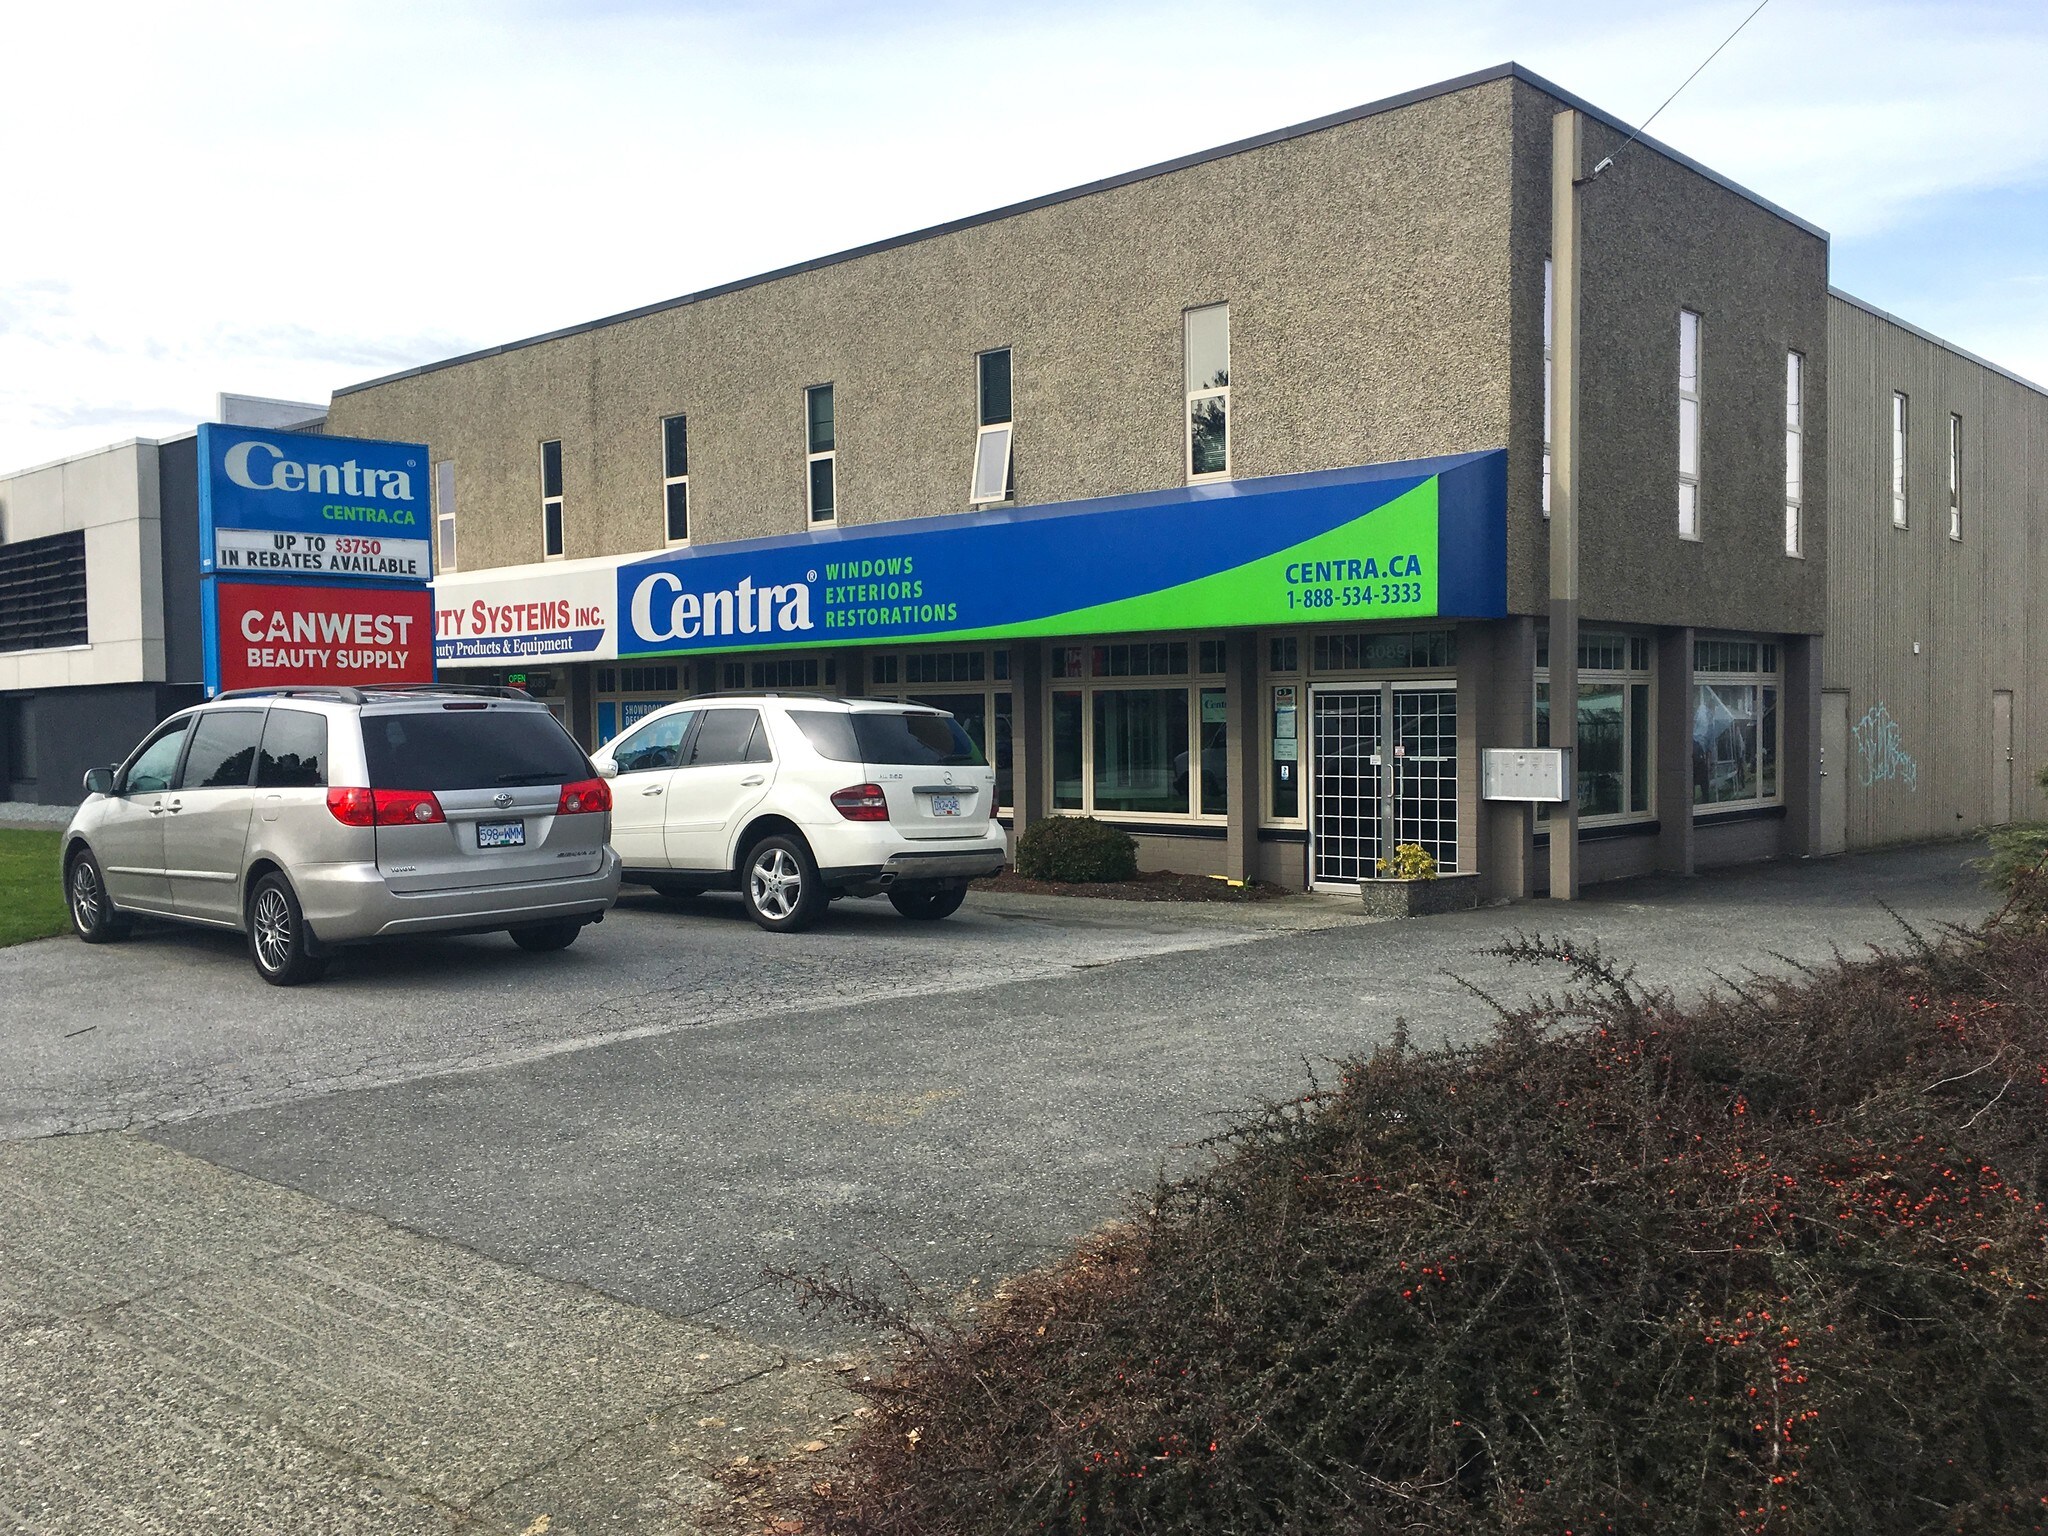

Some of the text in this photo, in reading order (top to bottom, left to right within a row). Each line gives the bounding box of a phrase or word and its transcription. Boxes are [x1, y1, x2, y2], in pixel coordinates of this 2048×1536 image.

[322, 505, 415, 525] CENTRA.CA
[274, 534, 382, 555] UP TO $3750
[222, 550, 417, 574] IN REBATES AVAILABLE
[826, 557, 913, 580] WINDOWS
[1285, 554, 1422, 584] CENTRA.CA
[826, 580, 923, 604] EXTERIORS
[1287, 582, 1422, 609] 1-888-534-3333
[472, 600, 570, 635] SYSTEMS
[575, 607, 605, 627] INC.
[826, 603, 957, 628] RESTORATIONS
[241, 610, 413, 645] CANWEST
[457, 639, 500, 656] Products
[502, 639, 511, 653] &
[513, 636, 573, 656] Equipment
[247, 648, 409, 669] BEAUTY SUPPLY
[508, 673, 527, 684] OPEN
[390, 865, 416, 873] TOYOTA
